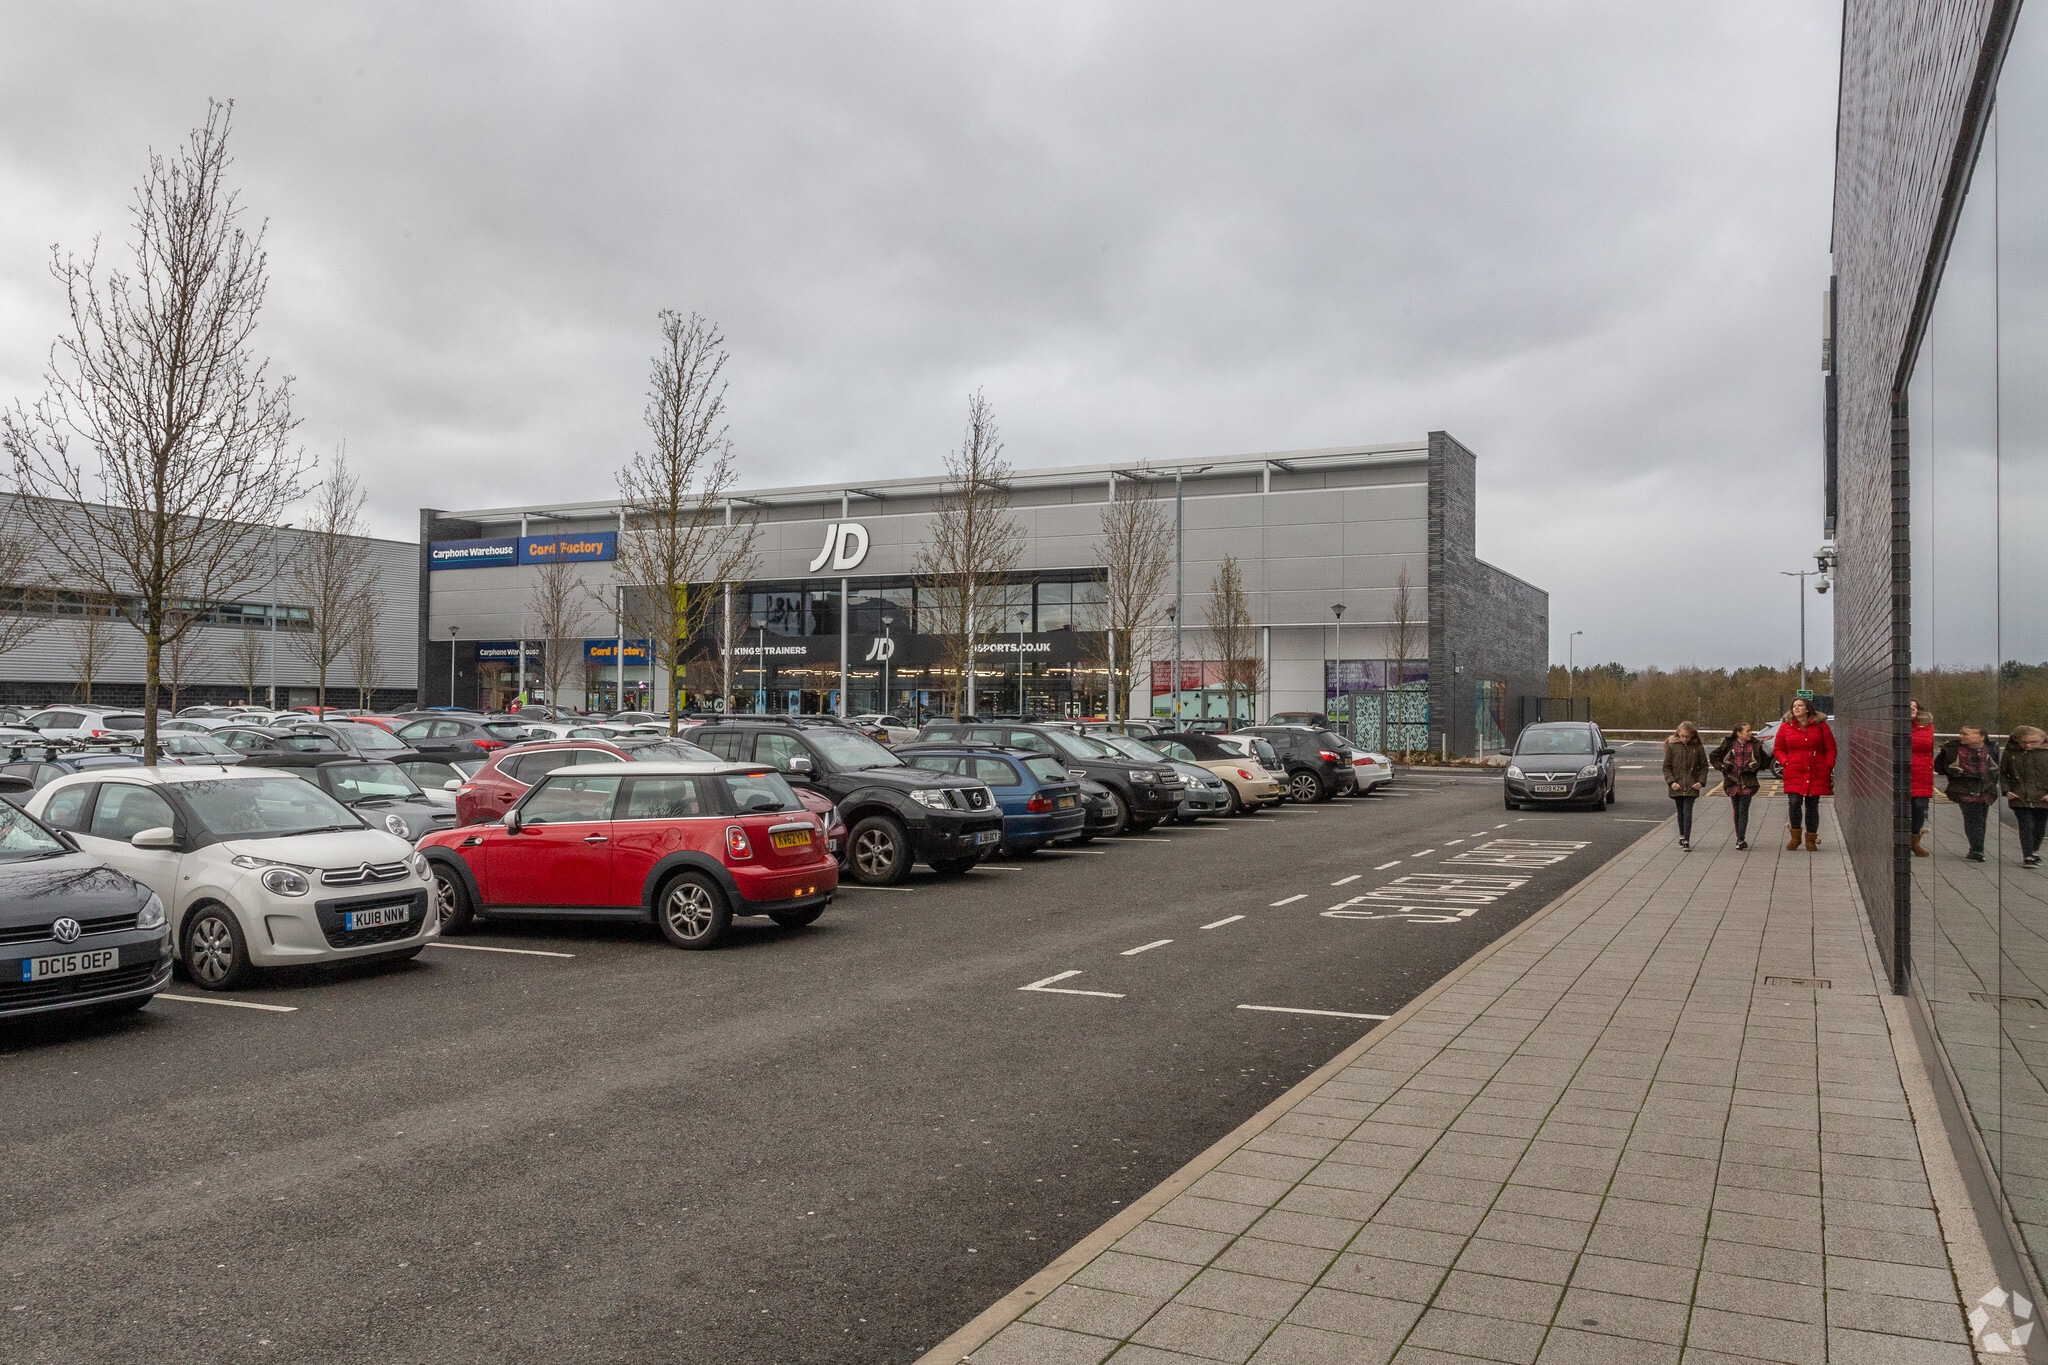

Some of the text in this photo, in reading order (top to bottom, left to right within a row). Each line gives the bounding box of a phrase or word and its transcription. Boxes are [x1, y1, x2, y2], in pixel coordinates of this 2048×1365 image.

[432, 545, 514, 560] Carphone Warehouse
[529, 541, 604, 556] Card Factory
[809, 522, 870, 573] JD
[480, 648, 540, 657] Carphone Warouse
[590, 646, 646, 658] Card Fctory
[734, 647, 755, 655] KING
[764, 646, 807, 655] TRAINERS
[866, 637, 895, 662] JD
[965, 643, 1051, 653] SPORTS.CO.UK
[777, 832, 796, 846] KV62
[1319, 838, 1593, 924] DELIVERY VEHICLES
[356, 907, 404, 927] KU18 NNW
[38, 951, 112, 976] DC15 OEP
